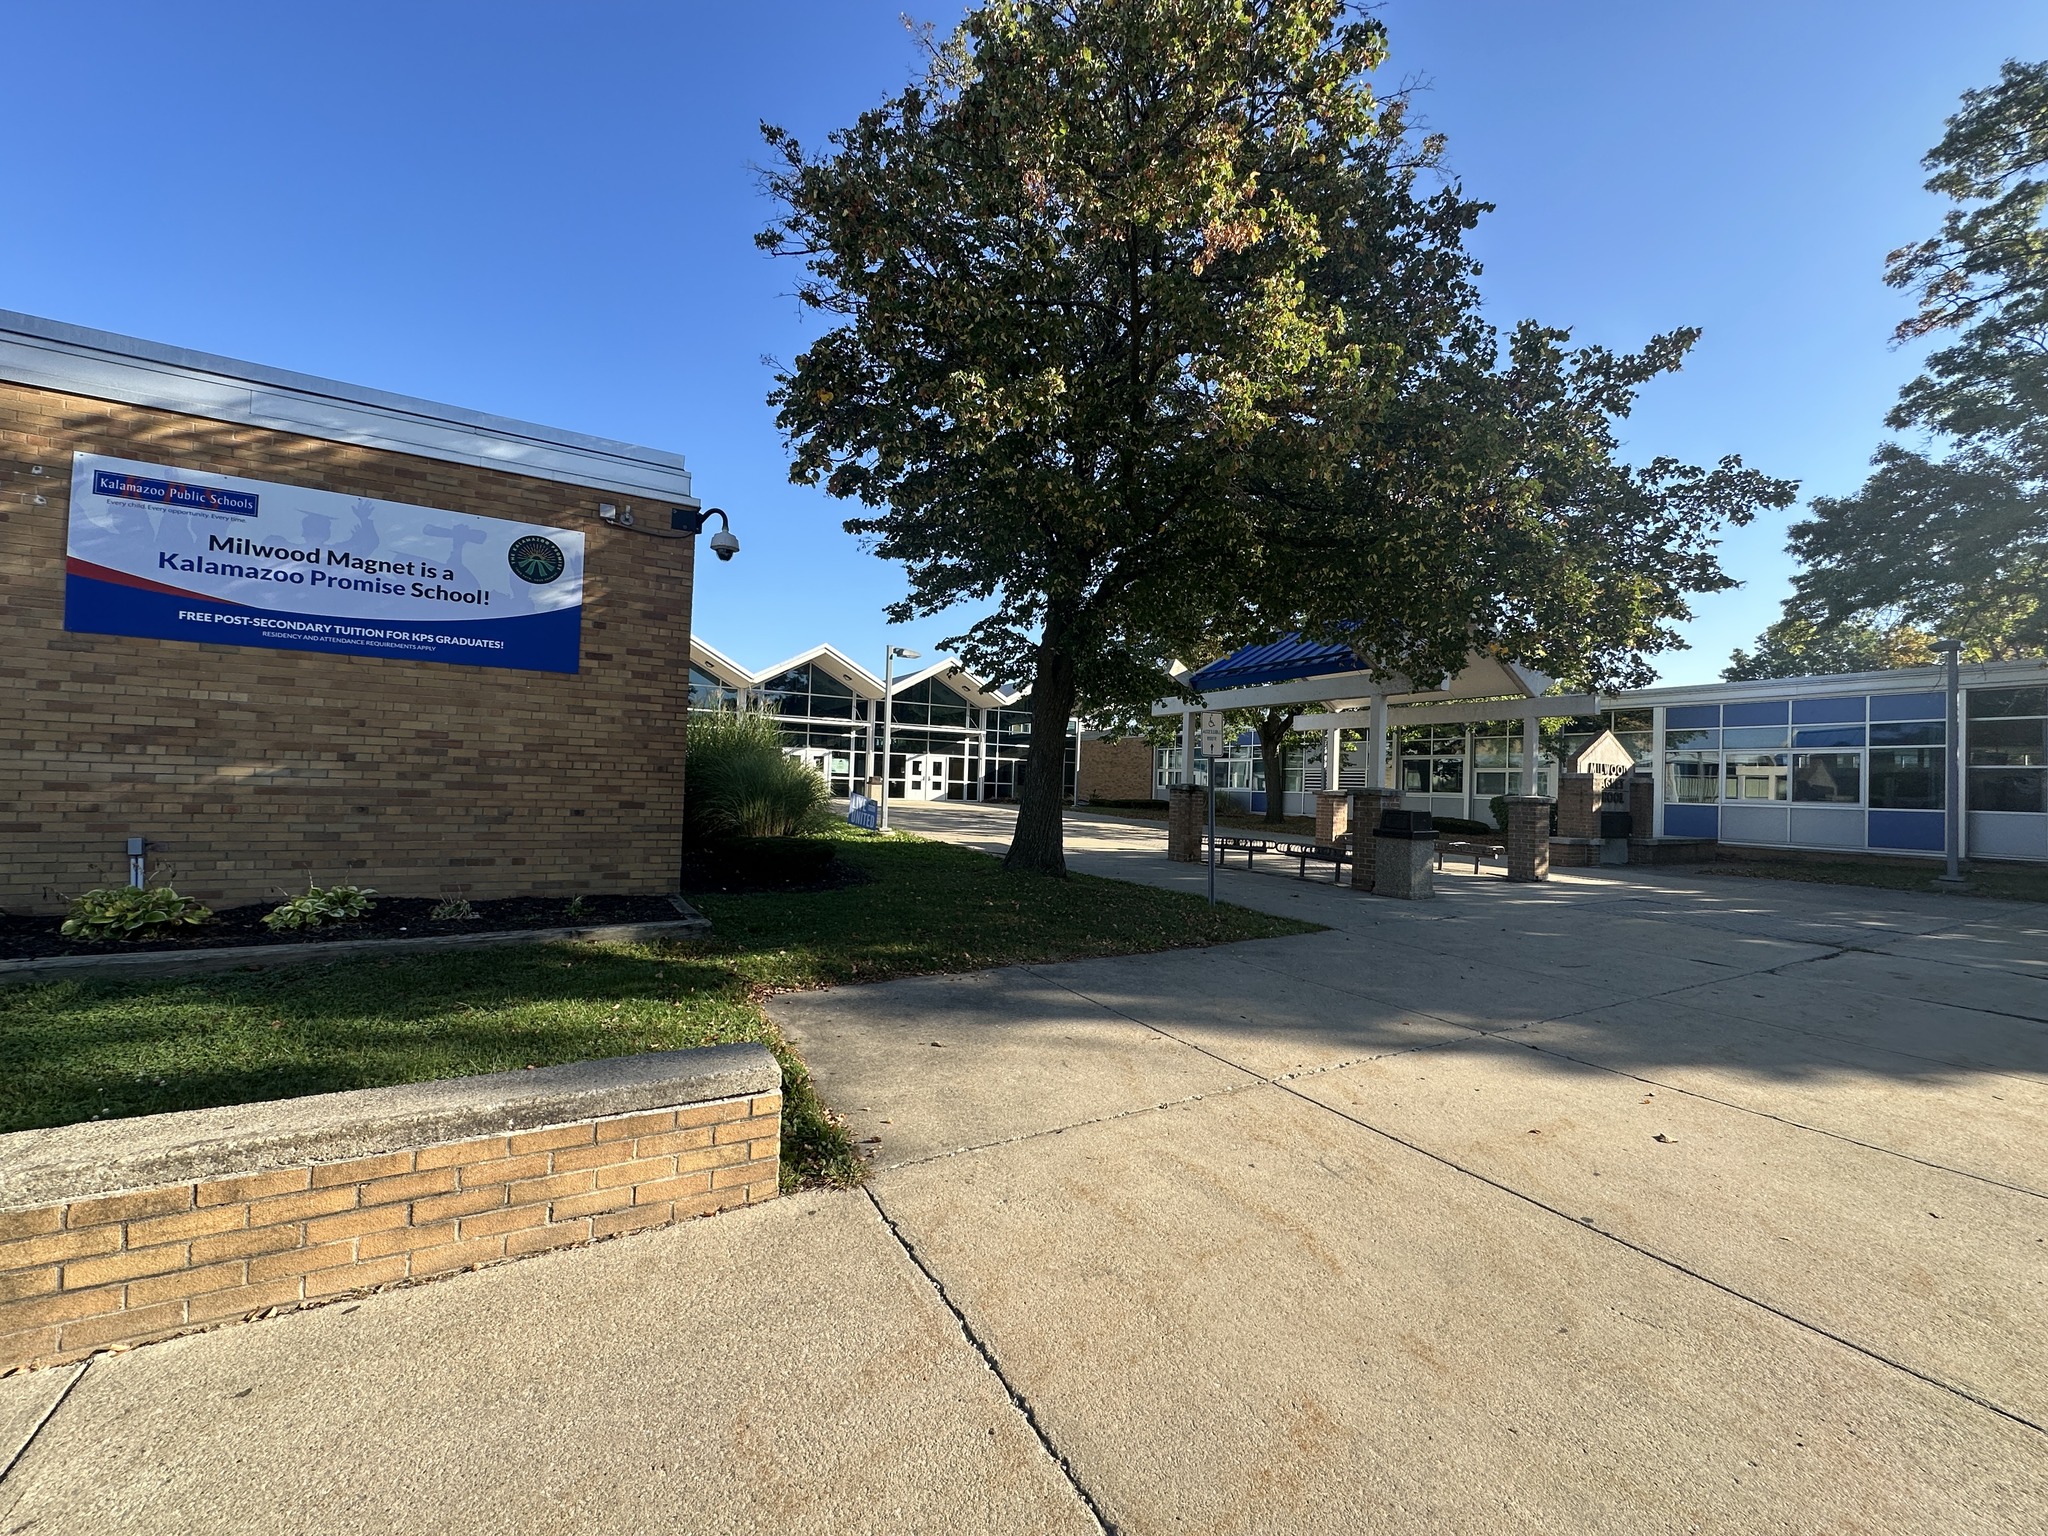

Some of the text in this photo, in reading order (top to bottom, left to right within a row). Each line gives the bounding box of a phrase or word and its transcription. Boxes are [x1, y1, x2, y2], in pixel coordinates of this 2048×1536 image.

[100, 477, 253, 510] Kalamazoo Public Schools
[106, 499, 127, 509] Every
[148, 504, 167, 515] Every
[211, 513, 230, 523] Every
[230, 516, 247, 524] time.
[208, 534, 455, 581] Milwood Magnet is a
[158, 551, 490, 606] Kalamazoo Promise School!
[178, 610, 505, 650] FREE POST-SECONDARY TUITION FOR KPS GRADUATES!
[262, 630, 302, 641] RESIDENCY
[319, 636, 366, 646] ATTENDANCE
[365, 640, 417, 650] REQUIREMENTS
[416, 644, 437, 652] APPLY
[1601, 791, 1625, 804] HOOL
[850, 811, 876, 828] UNITED
